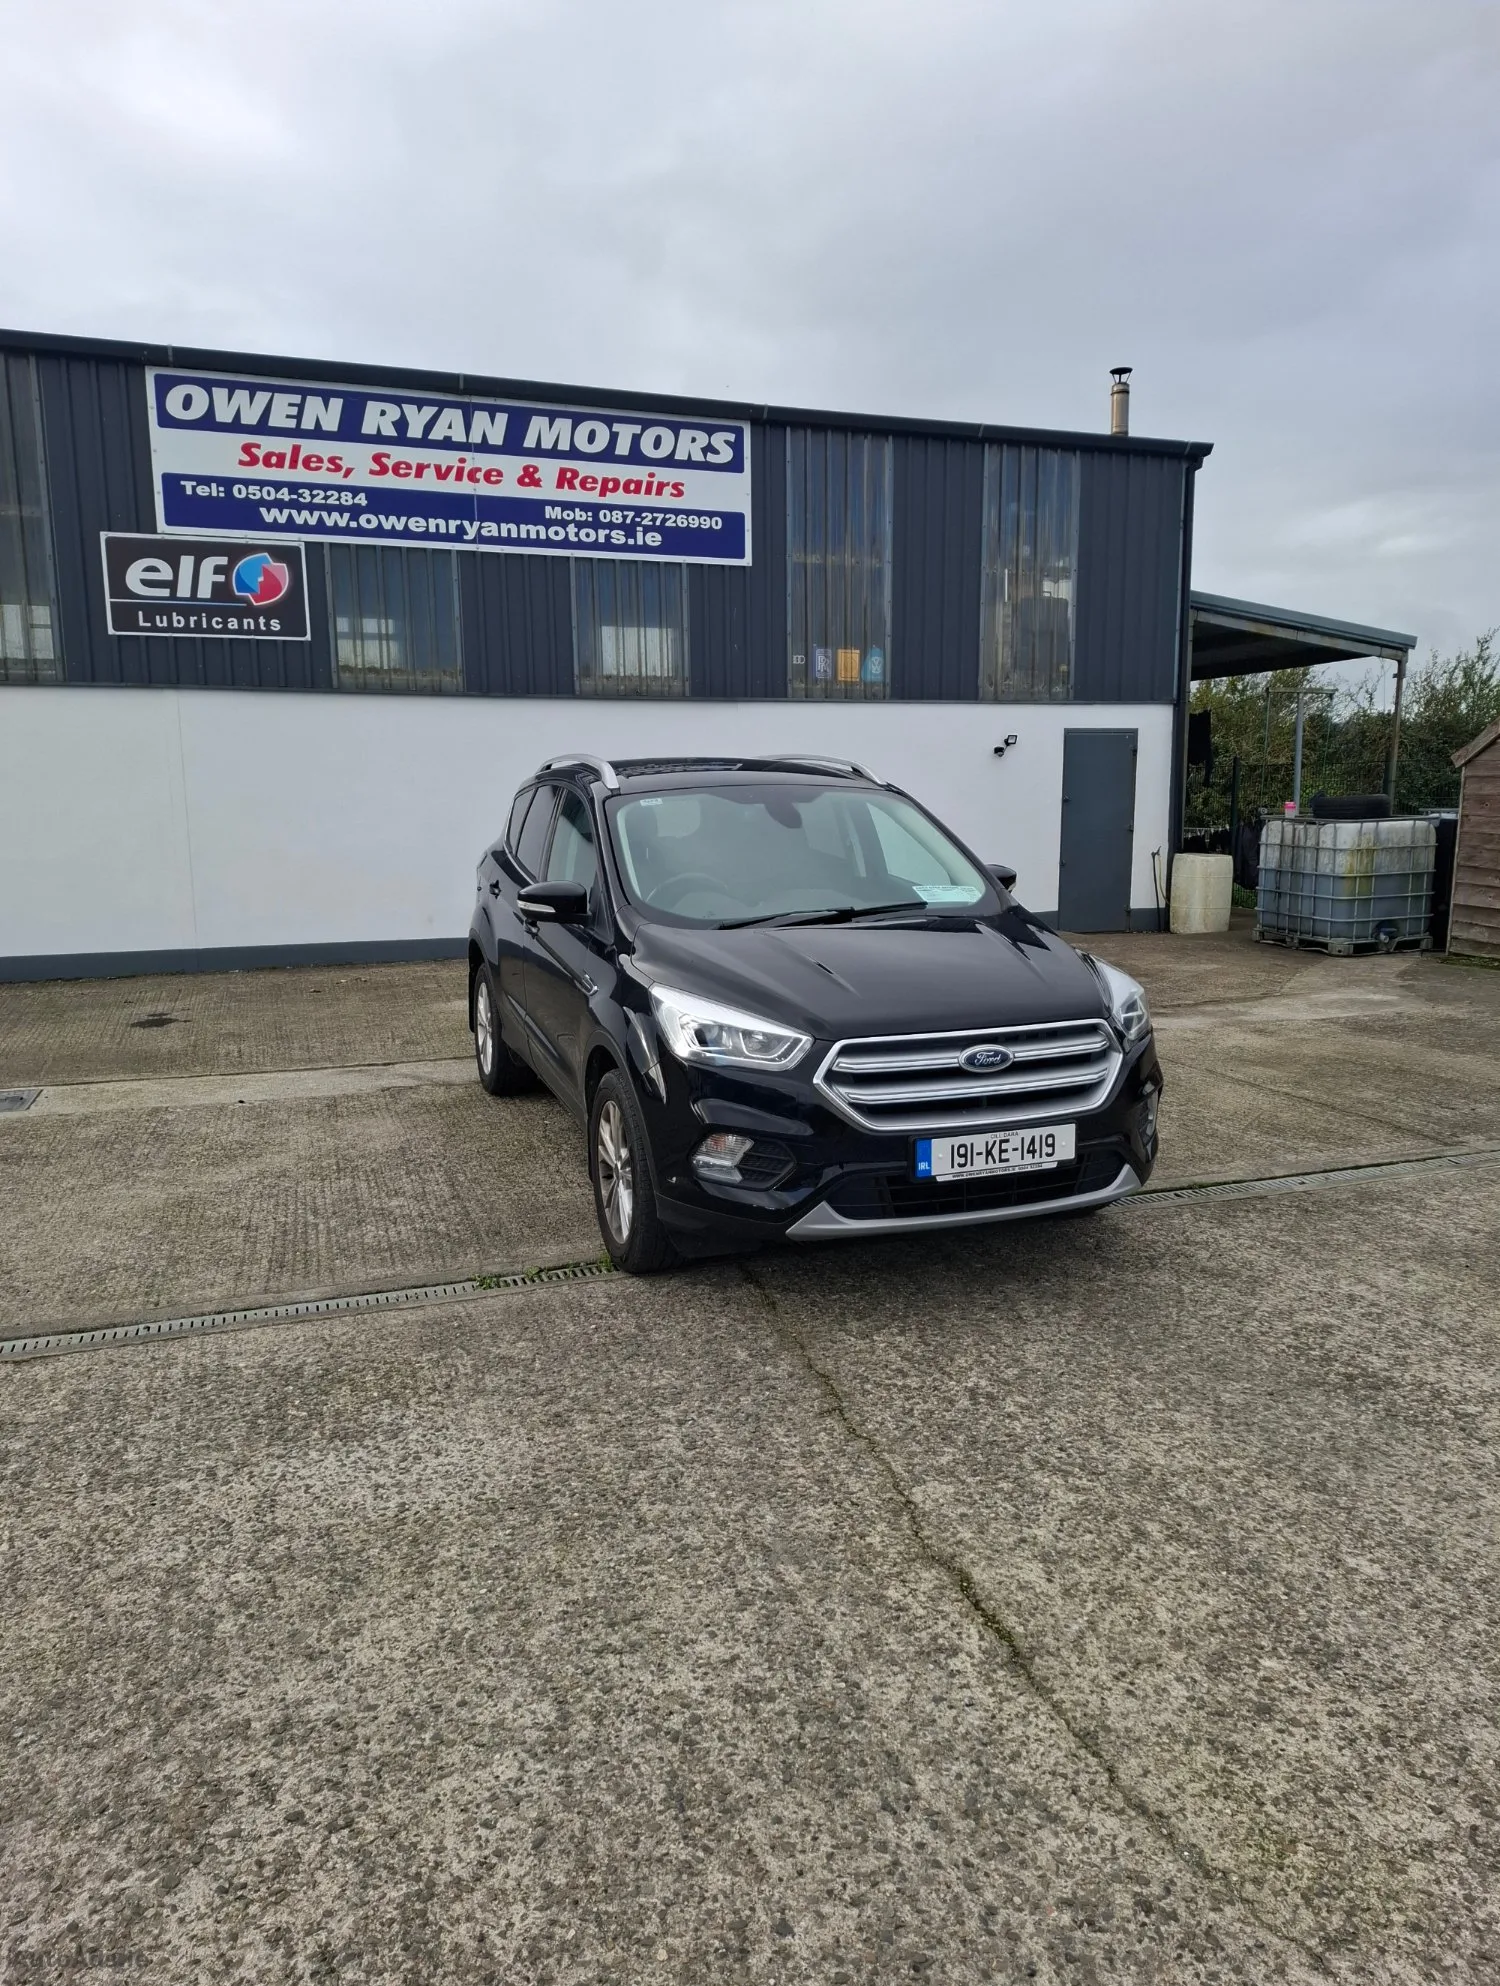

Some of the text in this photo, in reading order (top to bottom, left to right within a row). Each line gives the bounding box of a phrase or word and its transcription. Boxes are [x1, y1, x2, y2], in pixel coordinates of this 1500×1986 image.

[165, 384, 735, 464] OWEN RYAN MOTORS
[238, 442, 685, 498] Sales, Service & Repairs
[180, 480, 368, 506] Tel: 0504-32284
[259, 507, 662, 547] www.owenryanmotors.ie
[545, 505, 723, 530] Mob: 087-2726990
[125, 555, 228, 598] elf
[138, 610, 281, 631] Lubricants
[974, 1051, 1002, 1066] Ford
[918, 1161, 931, 1171] IRL
[950, 1133, 1056, 1169] 191-KE-1419
